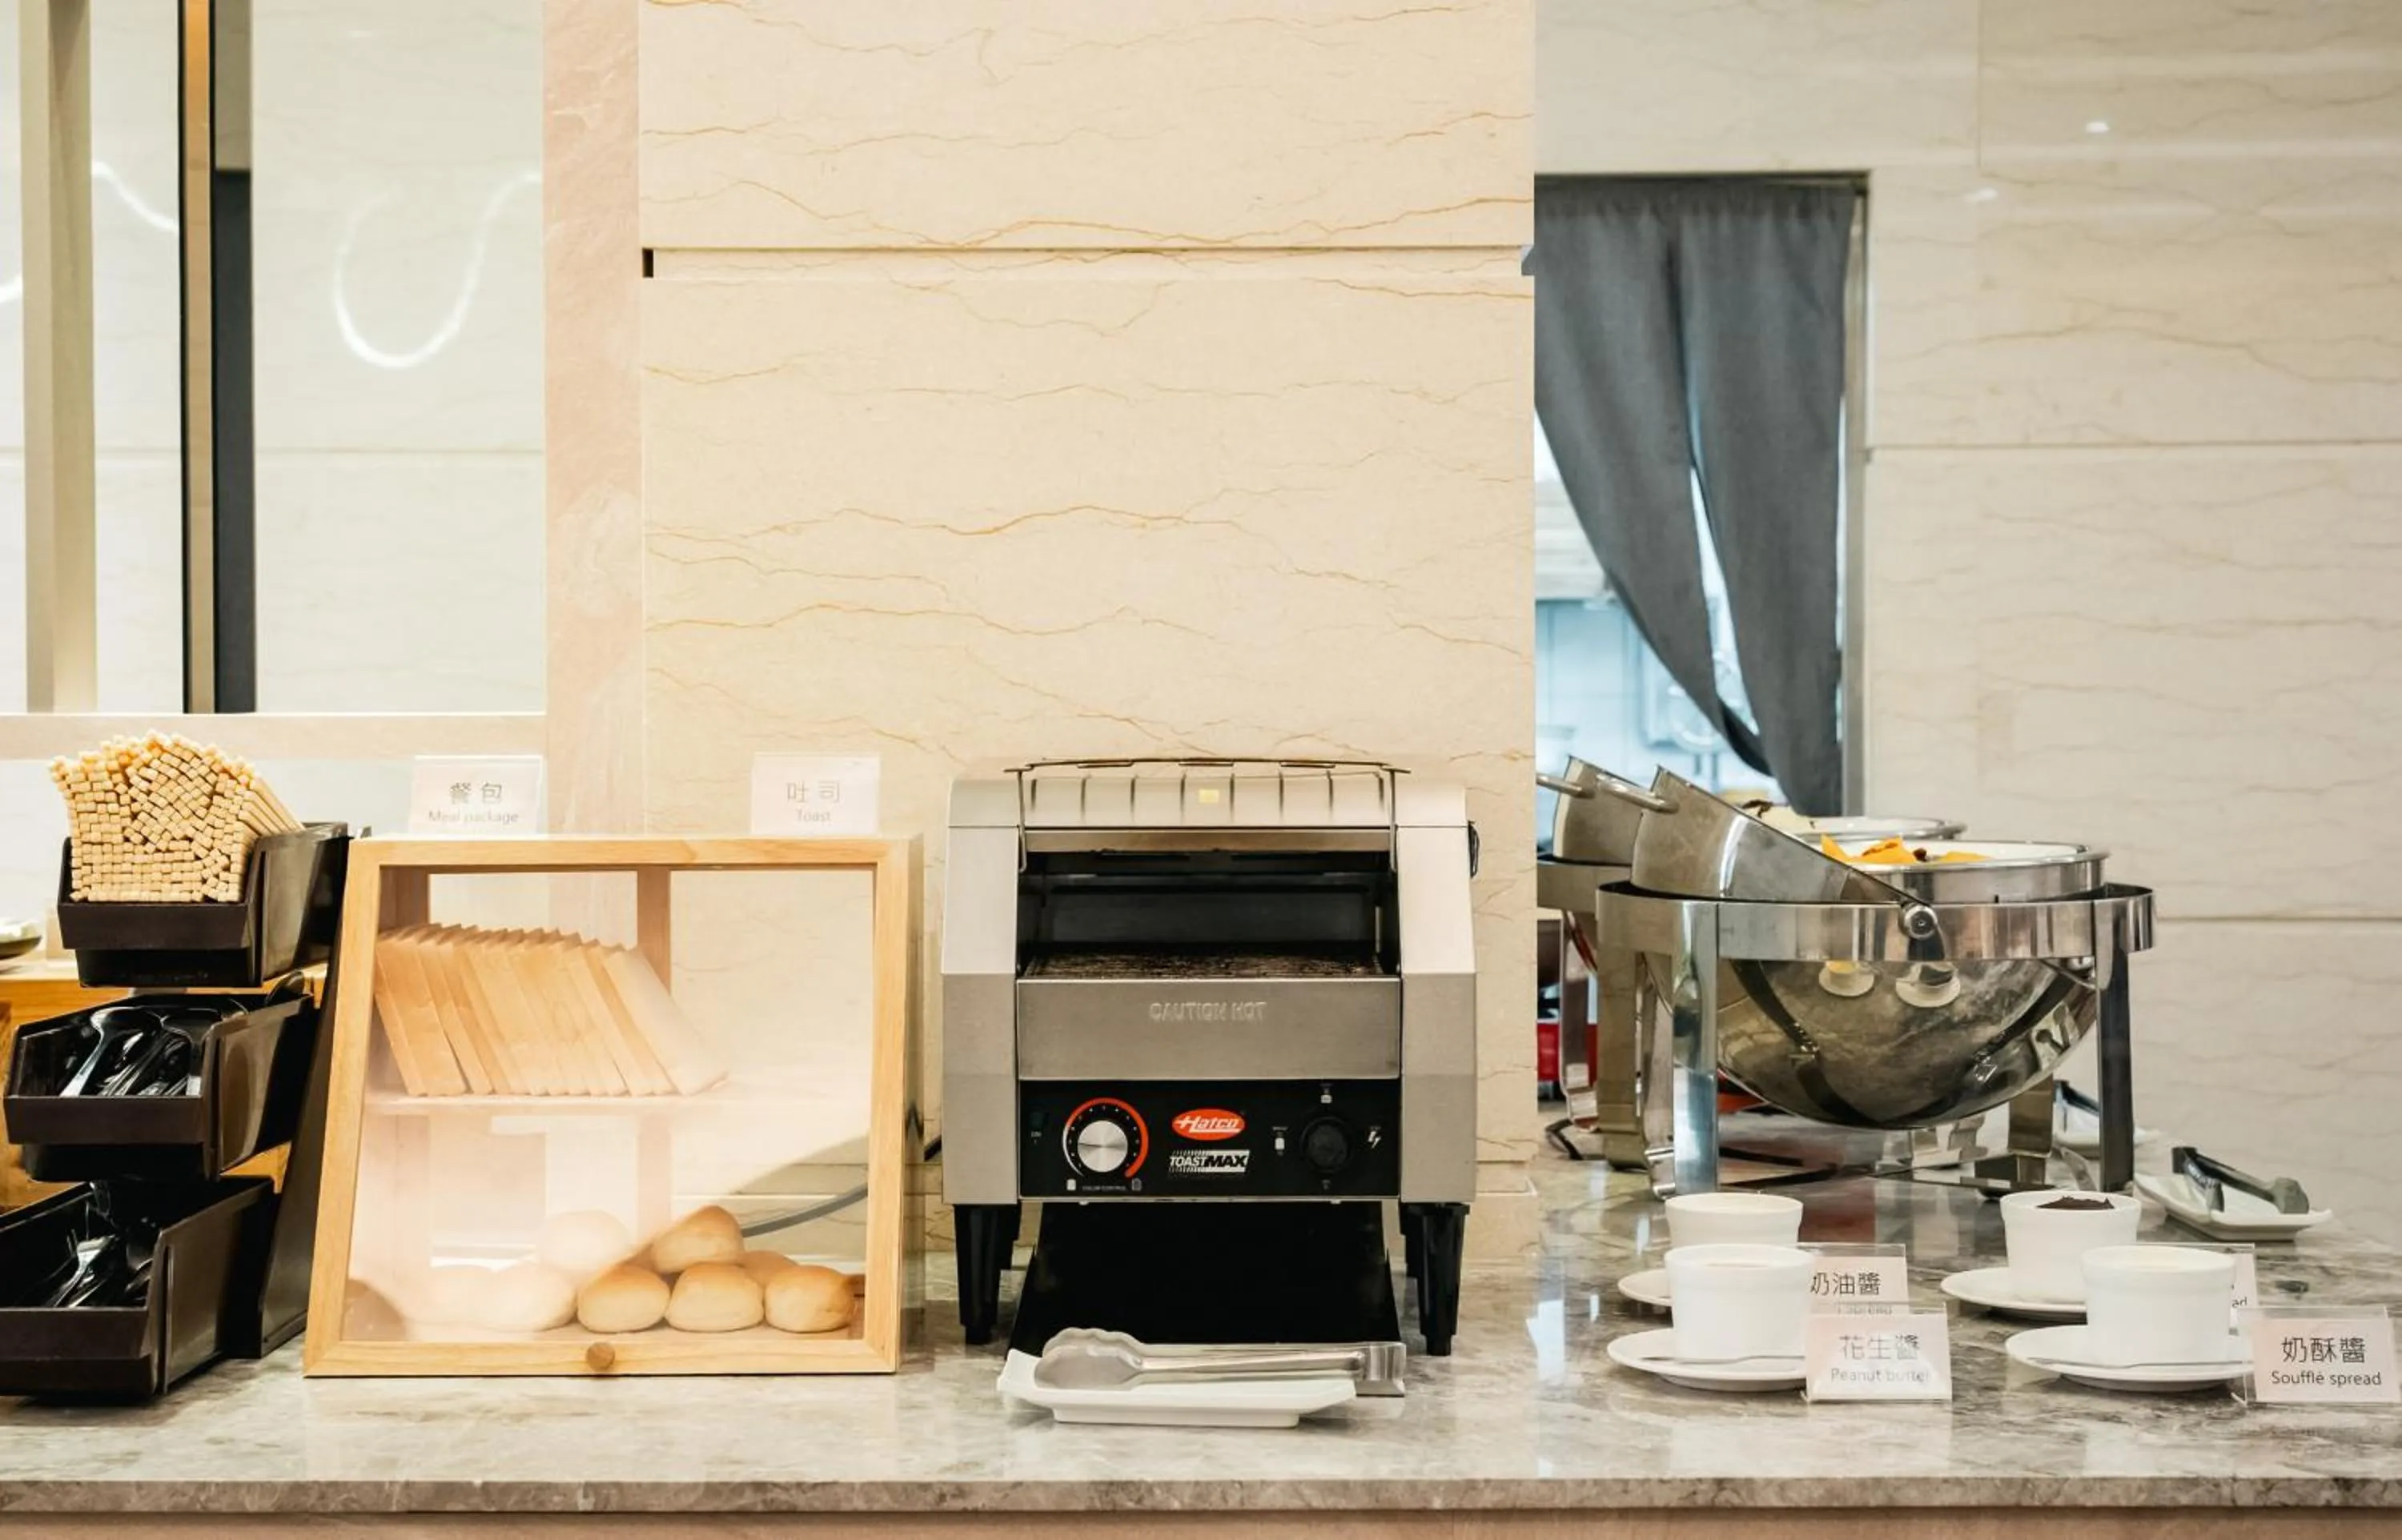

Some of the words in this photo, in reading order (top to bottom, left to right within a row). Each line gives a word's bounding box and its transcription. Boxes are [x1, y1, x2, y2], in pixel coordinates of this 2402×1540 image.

[785, 780, 840, 803] 吐司
[428, 808, 461, 822] Meal
[464, 809, 520, 825] package
[796, 808, 832, 822] Toast
[1149, 1001, 1227, 1022] CAUTION
[1231, 1001, 1267, 1022] HOT
[1175, 1115, 1243, 1134] Hatco
[1810, 1271, 1882, 1296] 奶油醬
[1838, 1333, 1921, 1361] 花生醬
[2281, 1337, 2366, 1364] 奶酥醬
[1830, 1367, 1882, 1382] Peanut
[2271, 1370, 2324, 1386] Soufflé
[2328, 1371, 2382, 1388] spread
